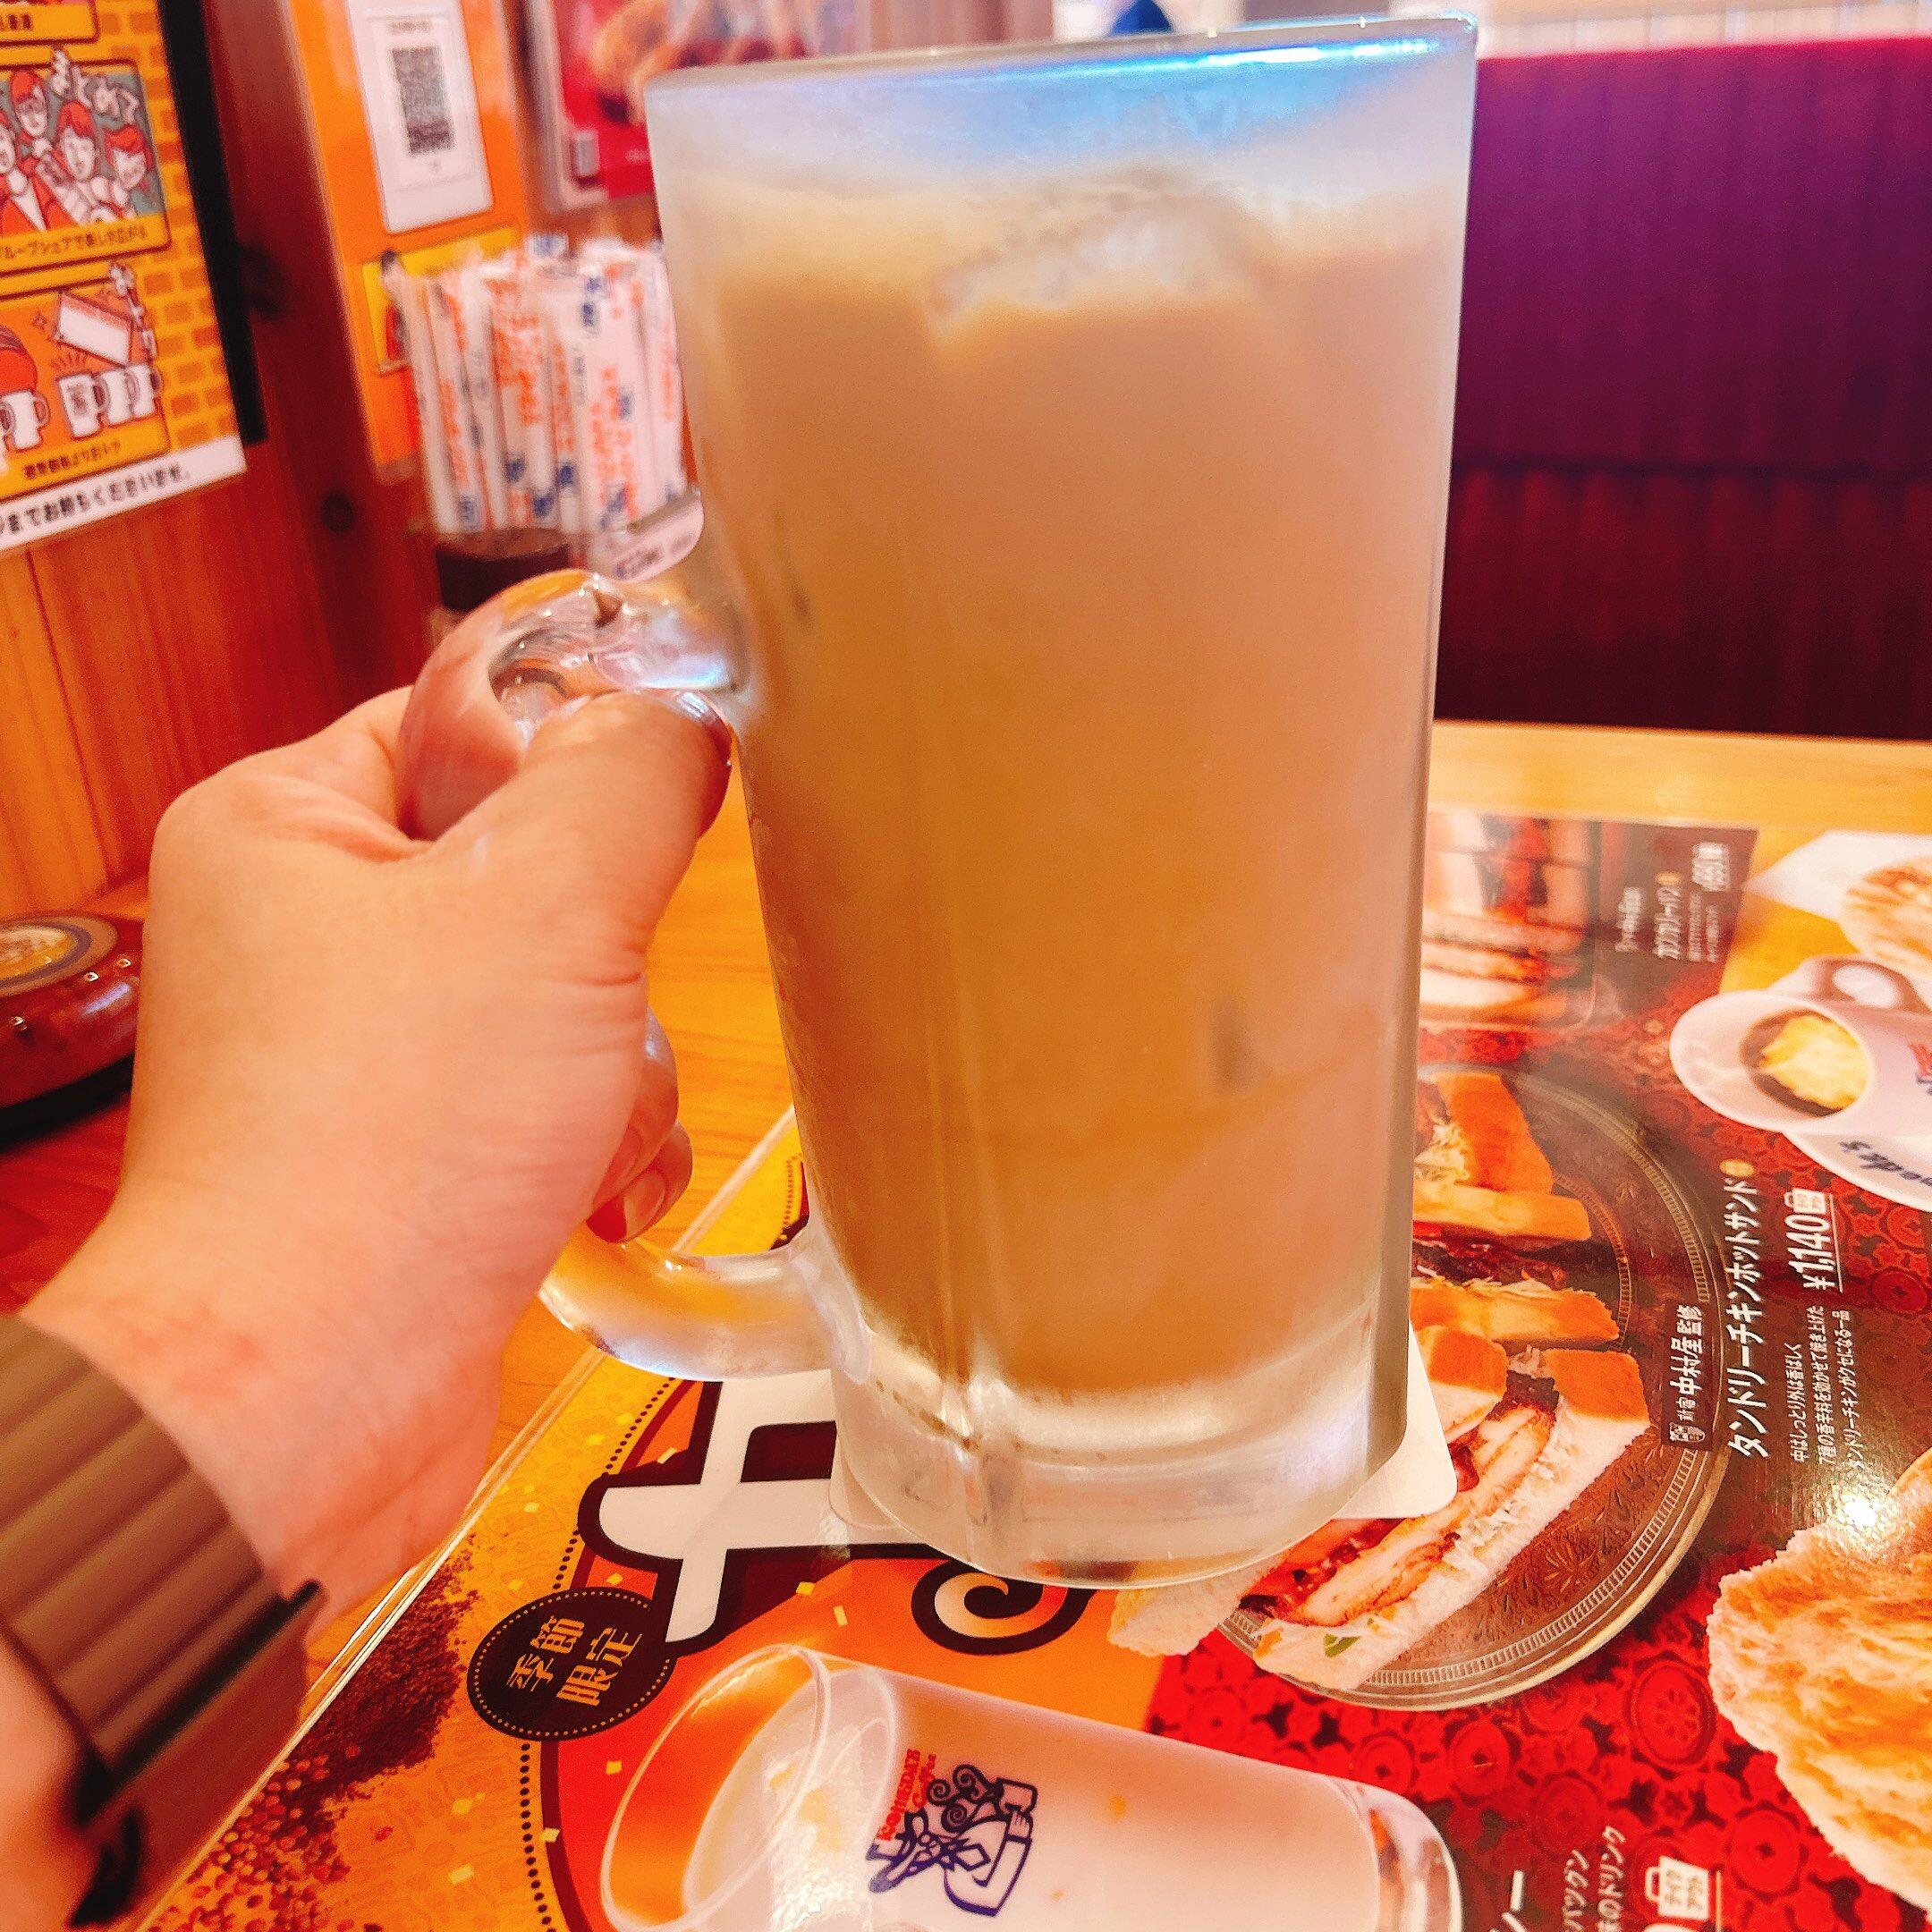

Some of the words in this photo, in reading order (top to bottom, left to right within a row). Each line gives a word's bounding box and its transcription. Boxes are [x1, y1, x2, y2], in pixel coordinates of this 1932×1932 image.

[1784, 1214, 1836, 1291] ¥1,140
[1723, 1178, 1769, 1459] タンドリーチキンホットサンド
[1784, 1342, 1808, 1463] 中はしっとり外は香ばしく
[1807, 1305, 1837, 1466] 7種の香辛料を効かせて焼き上げた
[1832, 1310, 1866, 1471] タンドリーチキンがクセになる一品
[505, 1614, 585, 1692] 季節
[555, 1627, 642, 1707] 限定
